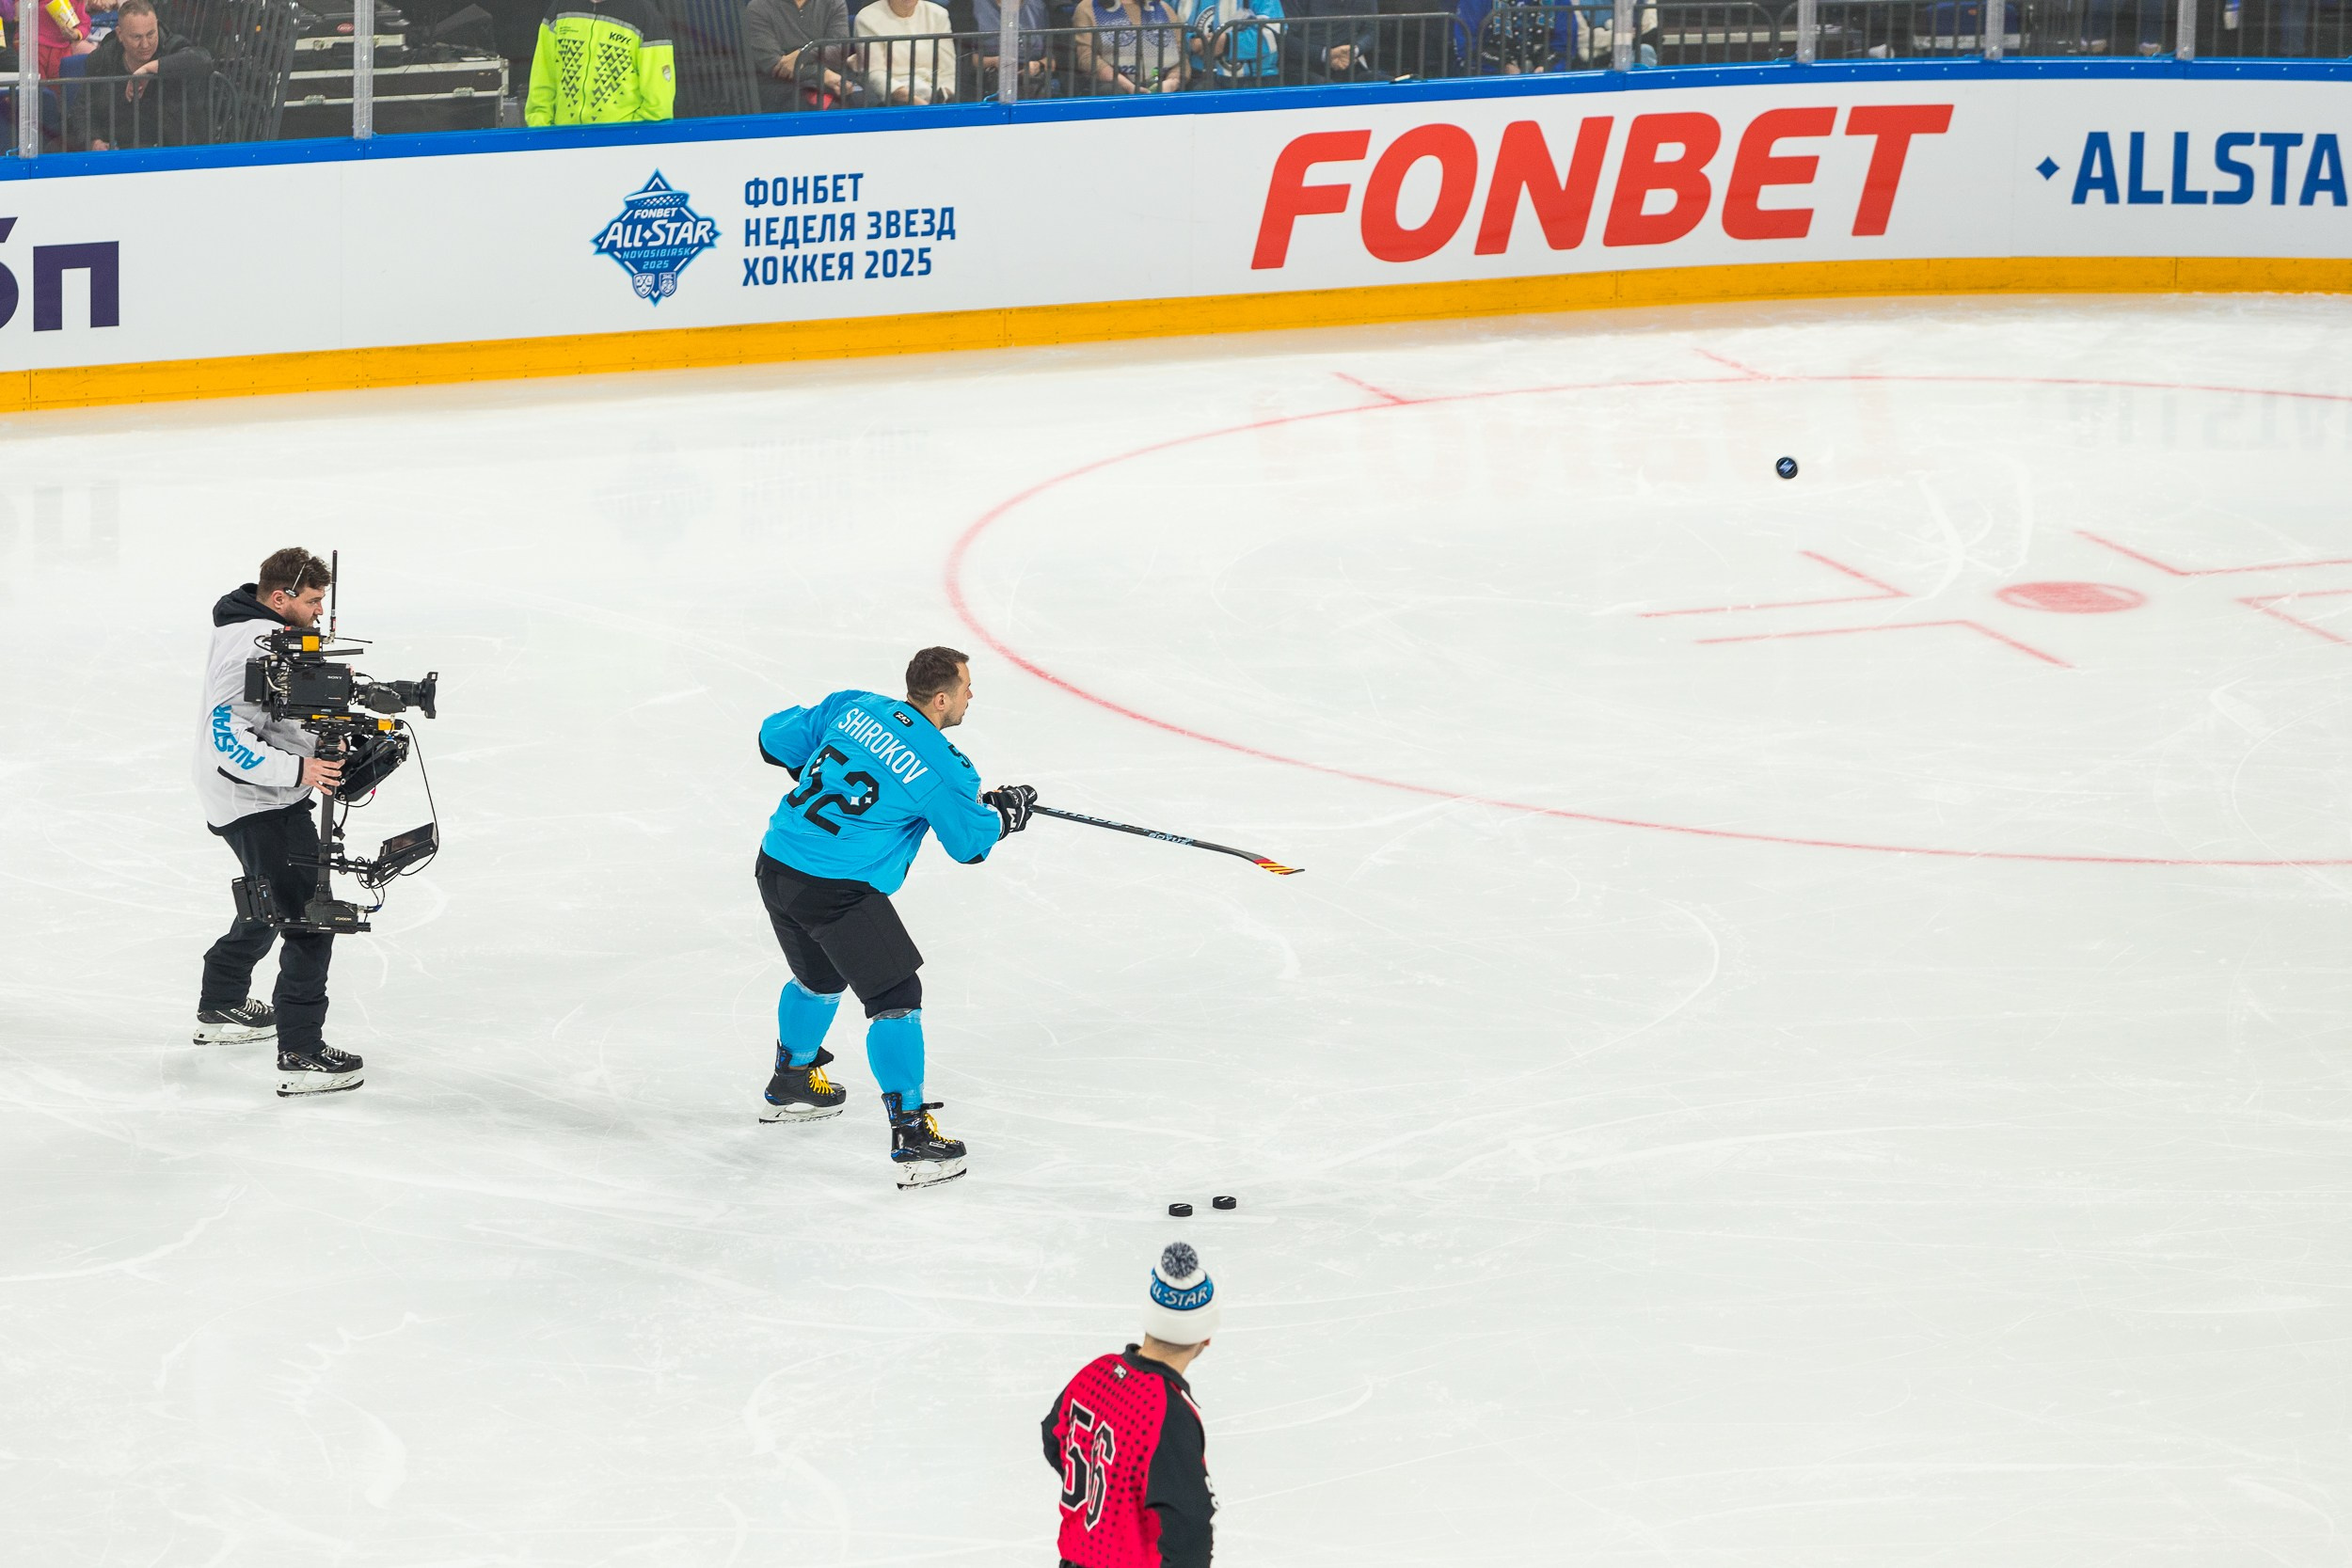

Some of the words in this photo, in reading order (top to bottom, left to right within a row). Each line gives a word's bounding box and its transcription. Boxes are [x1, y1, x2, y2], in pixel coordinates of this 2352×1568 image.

[744, 172, 865, 208] ФОНБЕТ
[1251, 103, 1955, 270] FONBET
[2072, 131, 2348, 207] ALLSTA
[633, 207, 678, 220] FONBET
[744, 212, 856, 250] НЕДЕЛЯ
[866, 207, 957, 241] ЗВЕЗД
[622, 247, 691, 260] NOVOSIBIRSK
[642, 260, 670, 270] 2025
[742, 251, 854, 287] ХОККЕЯ
[865, 246, 932, 279] 2025
[837, 707, 929, 785] SHIROKOV
[787, 744, 880, 836] 52
[230, 1008, 253, 1021] CCM
[1058, 1398, 1117, 1532] 56
